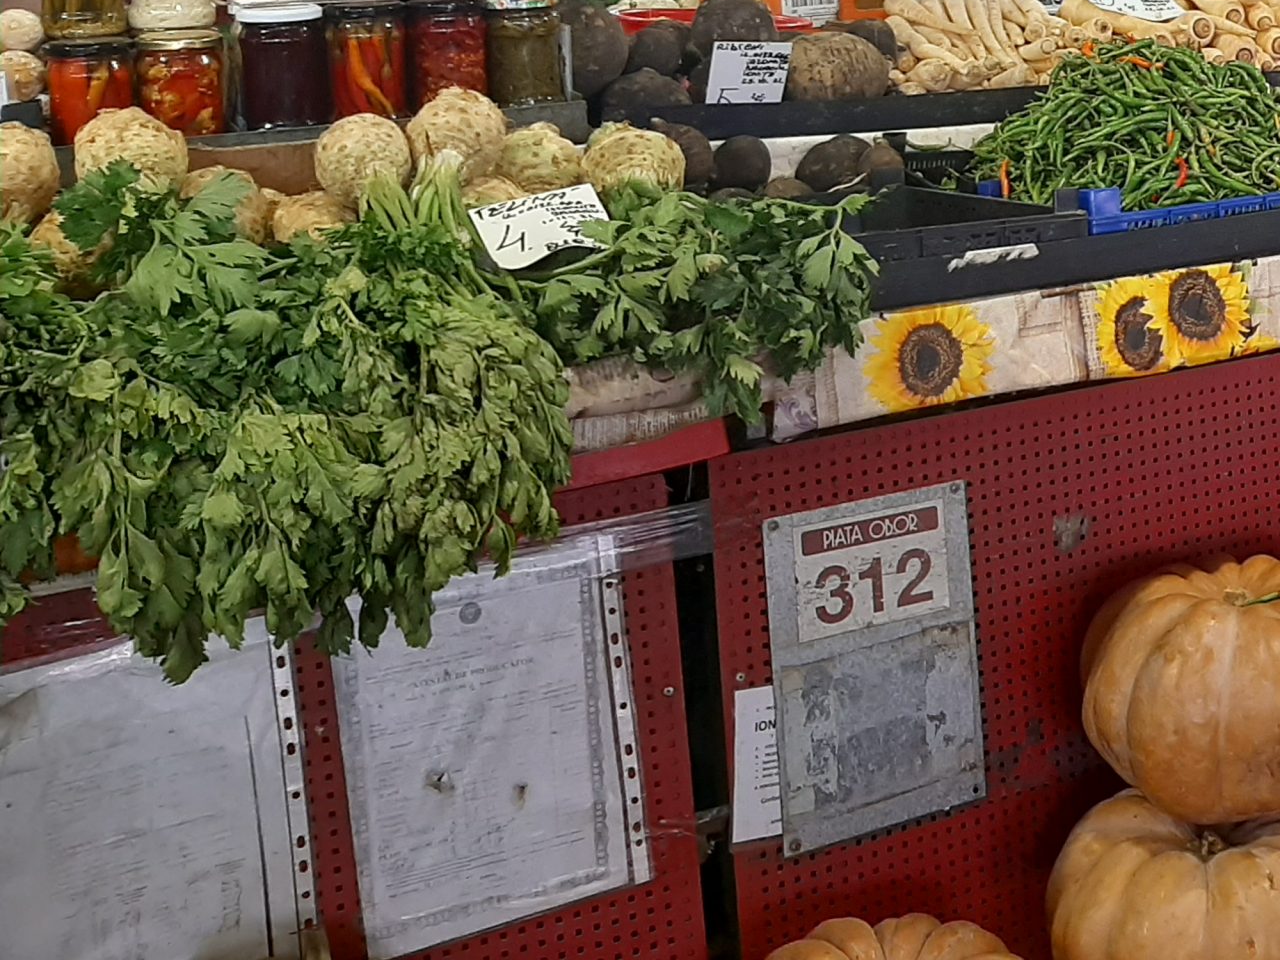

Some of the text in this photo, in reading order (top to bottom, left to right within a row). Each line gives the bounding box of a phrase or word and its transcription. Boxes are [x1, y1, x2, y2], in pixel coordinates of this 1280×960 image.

[822, 513, 919, 550] PIATA OBOR
[814, 547, 935, 625] 312
